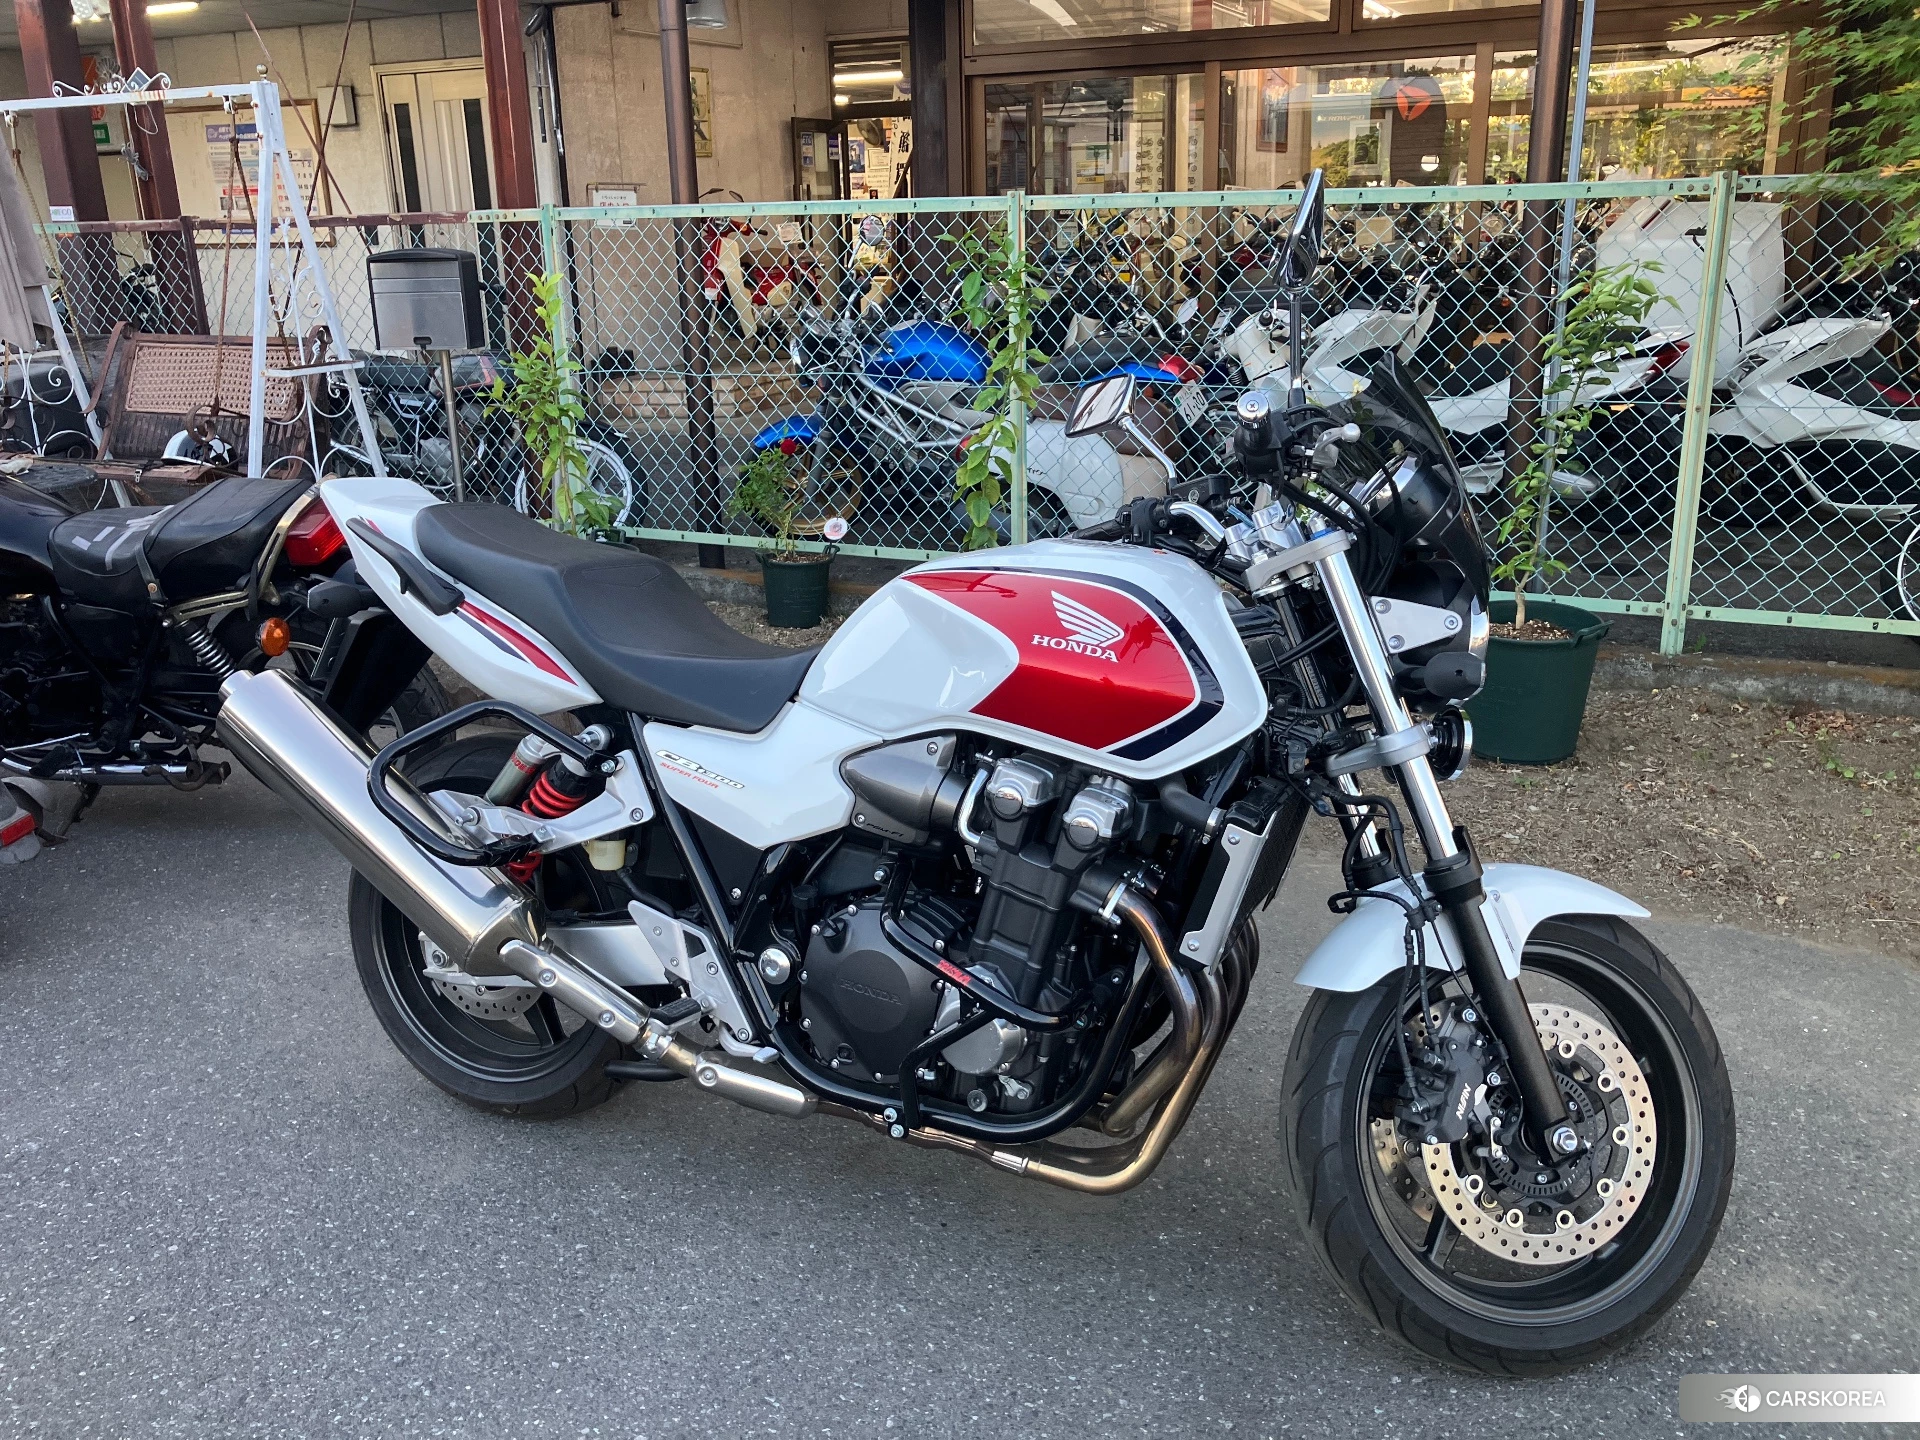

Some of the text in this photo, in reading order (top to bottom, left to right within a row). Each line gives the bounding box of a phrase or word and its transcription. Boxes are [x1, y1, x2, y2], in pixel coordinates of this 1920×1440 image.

[1030, 634, 1119, 663] HONDA
[660, 762, 719, 789] SUPER FOUR
[838, 977, 904, 1006] HONDA
